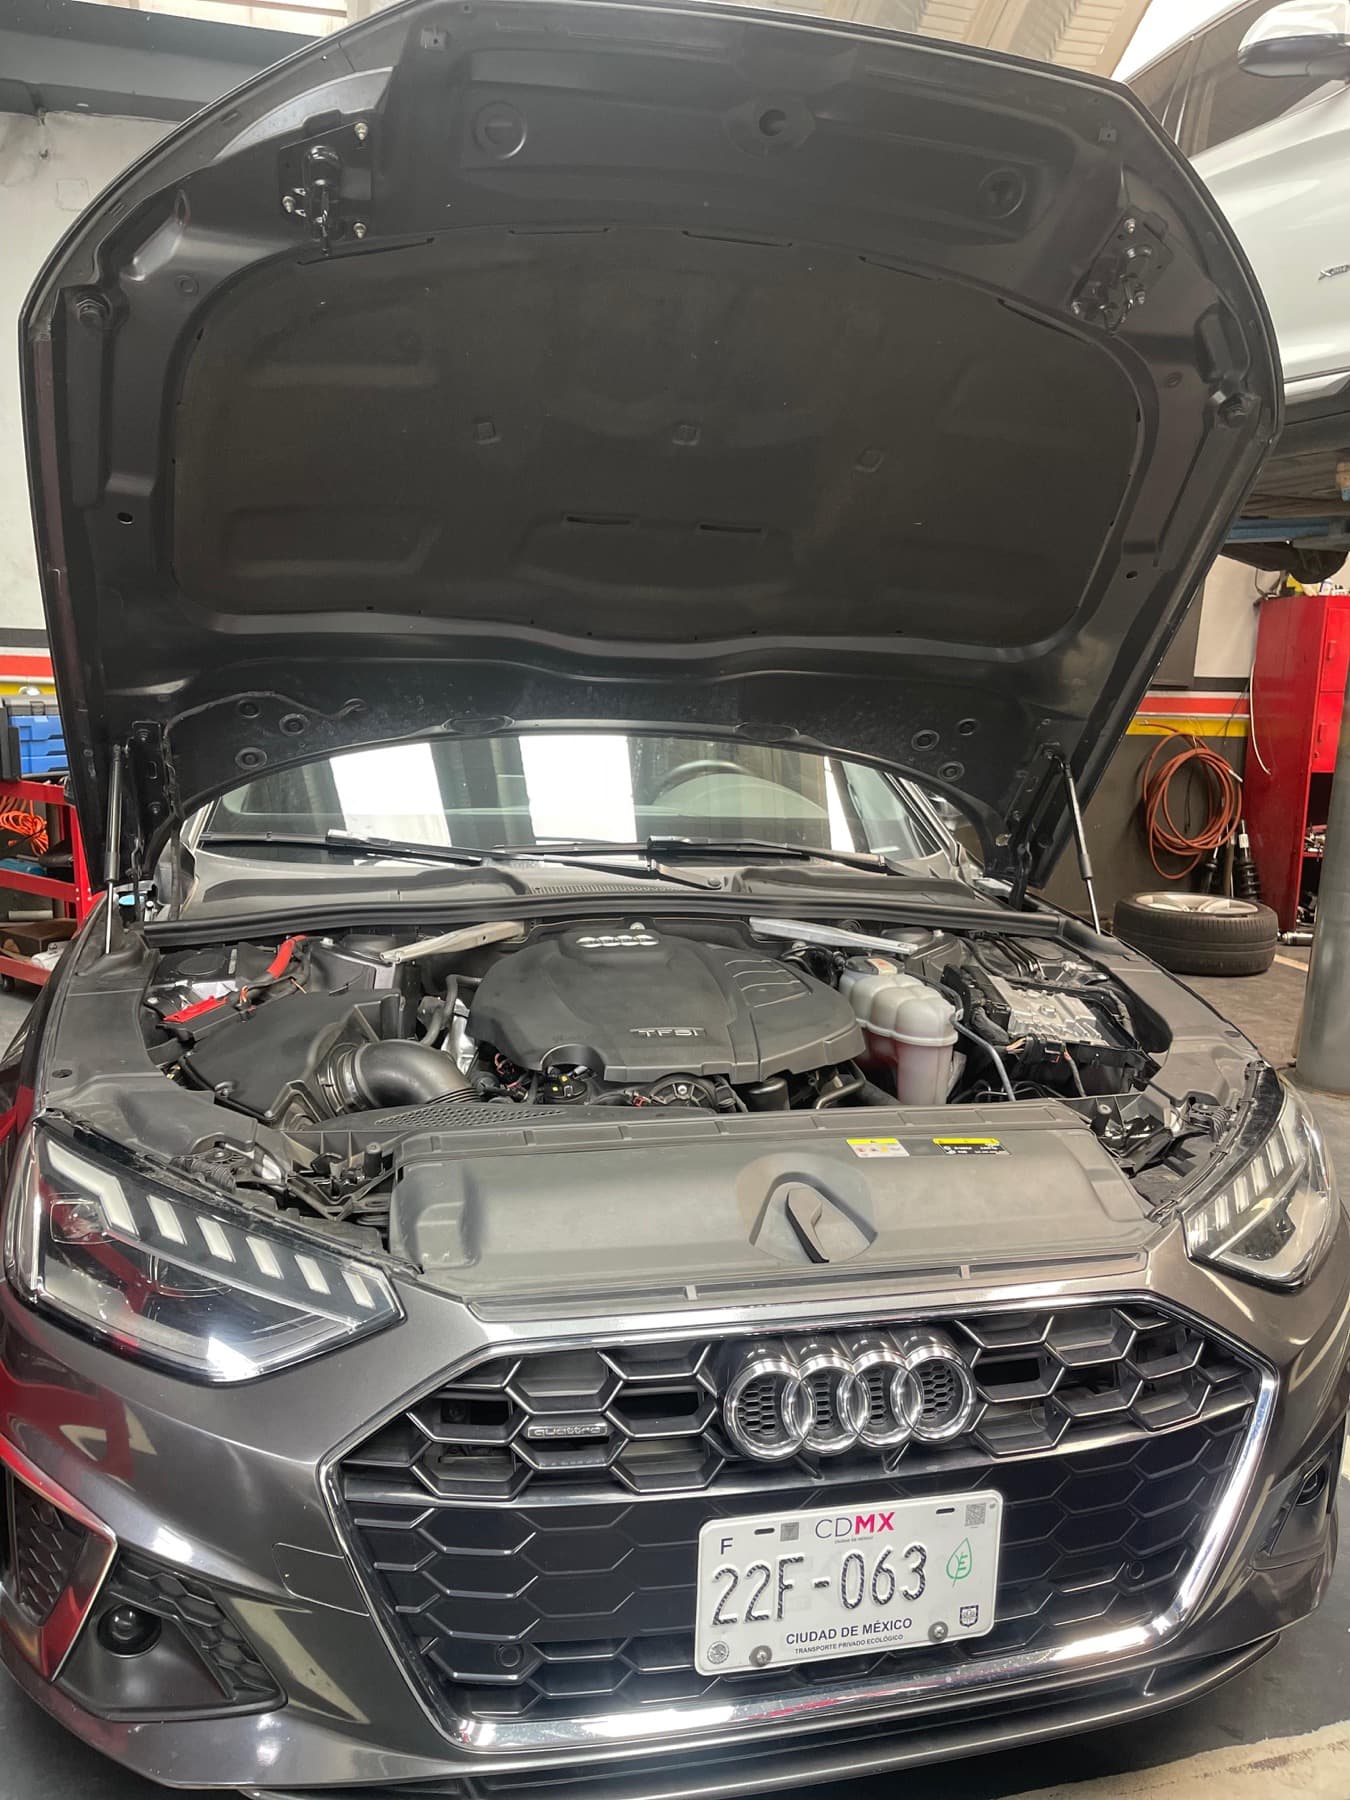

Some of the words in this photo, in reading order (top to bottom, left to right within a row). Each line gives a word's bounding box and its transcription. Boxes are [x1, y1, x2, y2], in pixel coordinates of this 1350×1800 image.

[629, 1026, 704, 1039] TFSI
[534, 1426, 601, 1438] quattro
[815, 1511, 895, 1538] CDMX
[720, 1537, 733, 1554] F
[711, 1543, 928, 1627] 22F-063
[786, 1628, 837, 1645] CIUDAD
[841, 1625, 859, 1638] DE
[862, 1617, 913, 1635] MÉXICO
[795, 1643, 837, 1655] TRANSPORTE
[838, 1638, 866, 1650] PRIVADO
[866, 1633, 904, 1646] ECOLÓGICO
